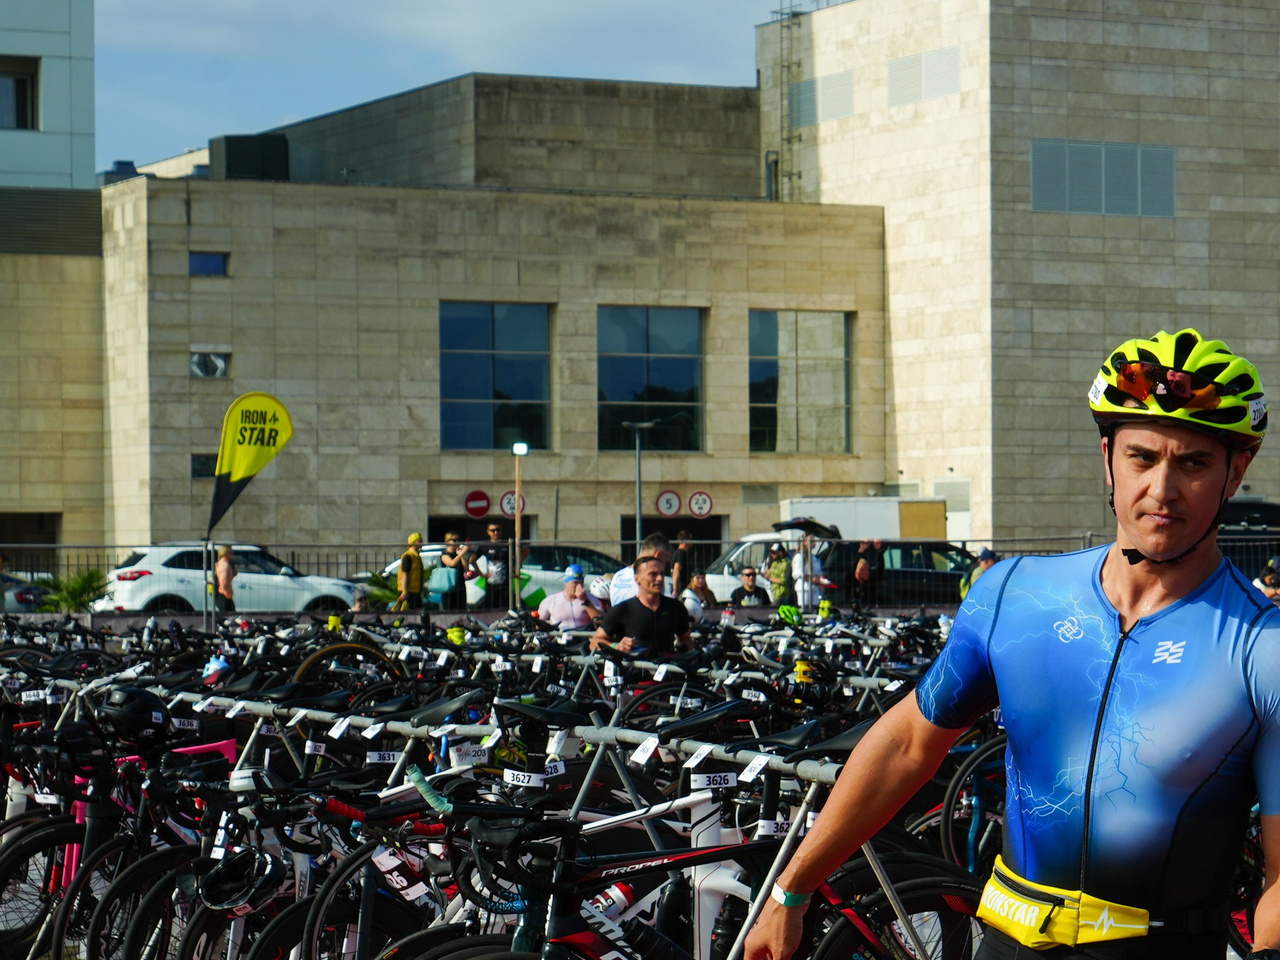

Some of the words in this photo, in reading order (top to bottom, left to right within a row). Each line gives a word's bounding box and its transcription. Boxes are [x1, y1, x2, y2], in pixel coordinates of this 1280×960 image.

[241, 409, 267, 425] IRON
[238, 427, 279, 447] STAR
[665, 499, 673, 510] 5
[377, 753, 395, 761] 3631
[472, 749, 486, 757] 203
[543, 763, 559, 776] 628
[511, 772, 532, 784] 3627
[705, 774, 729, 786] 3626
[601, 858, 674, 878] PROPEL
[982, 884, 1040, 928] RONSTAR
